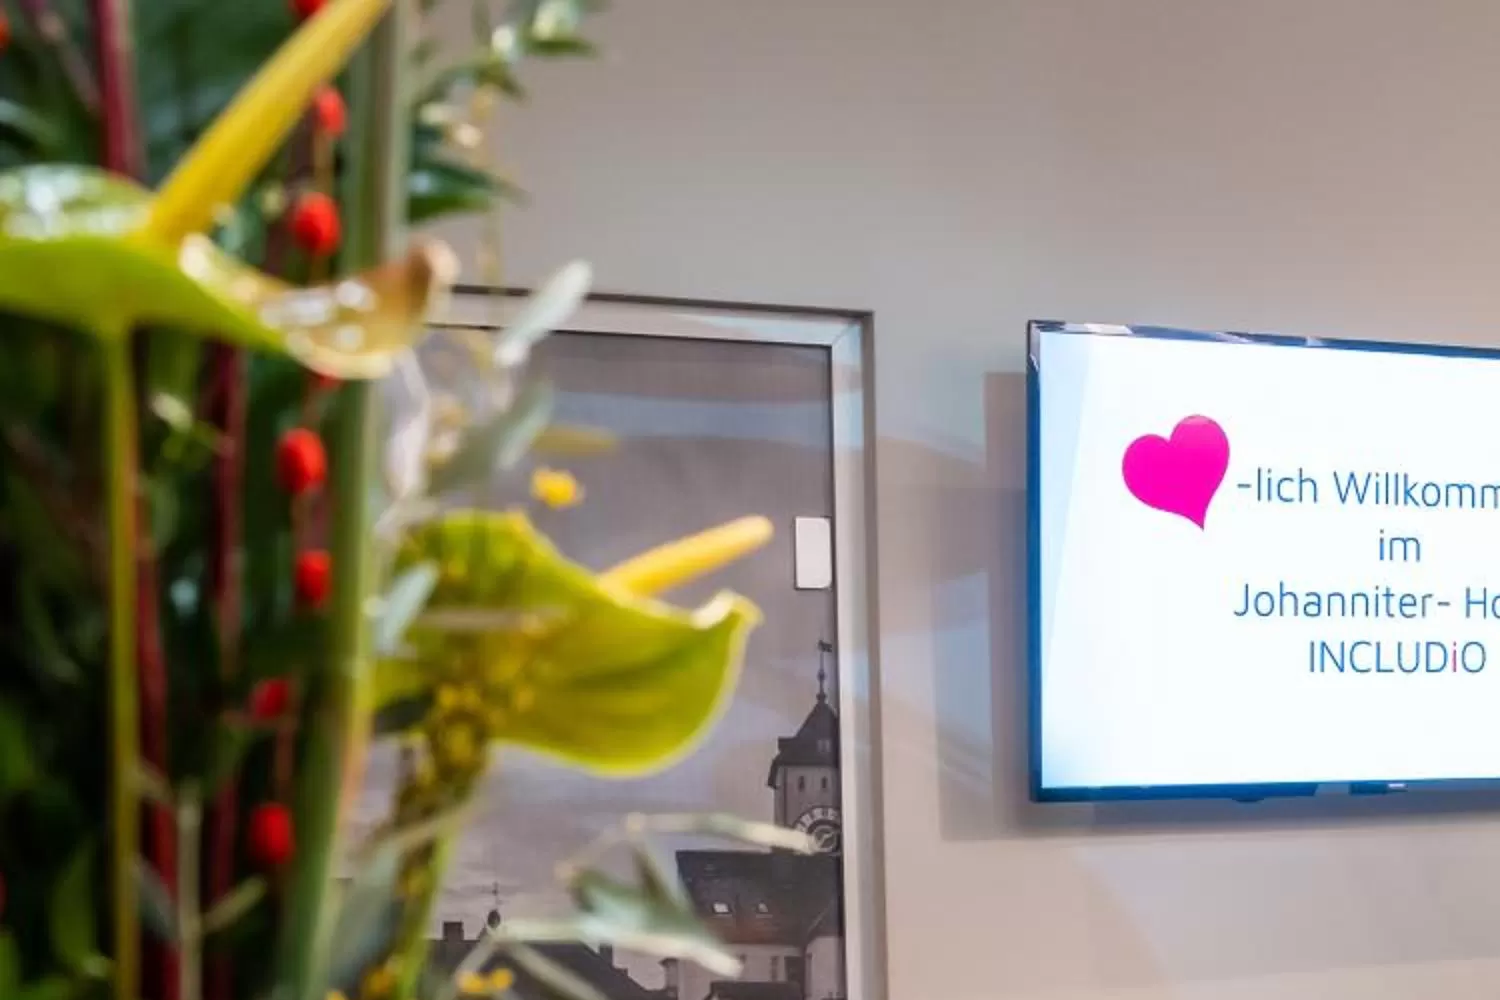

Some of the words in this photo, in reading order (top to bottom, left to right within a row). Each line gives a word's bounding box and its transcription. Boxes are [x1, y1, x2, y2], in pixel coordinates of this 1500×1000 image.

[1236, 466, 1319, 503] -lich
[1379, 528, 1421, 562] im
[1234, 581, 1450, 619] Johanniter-
[1309, 640, 1487, 674] INCLUDiO
